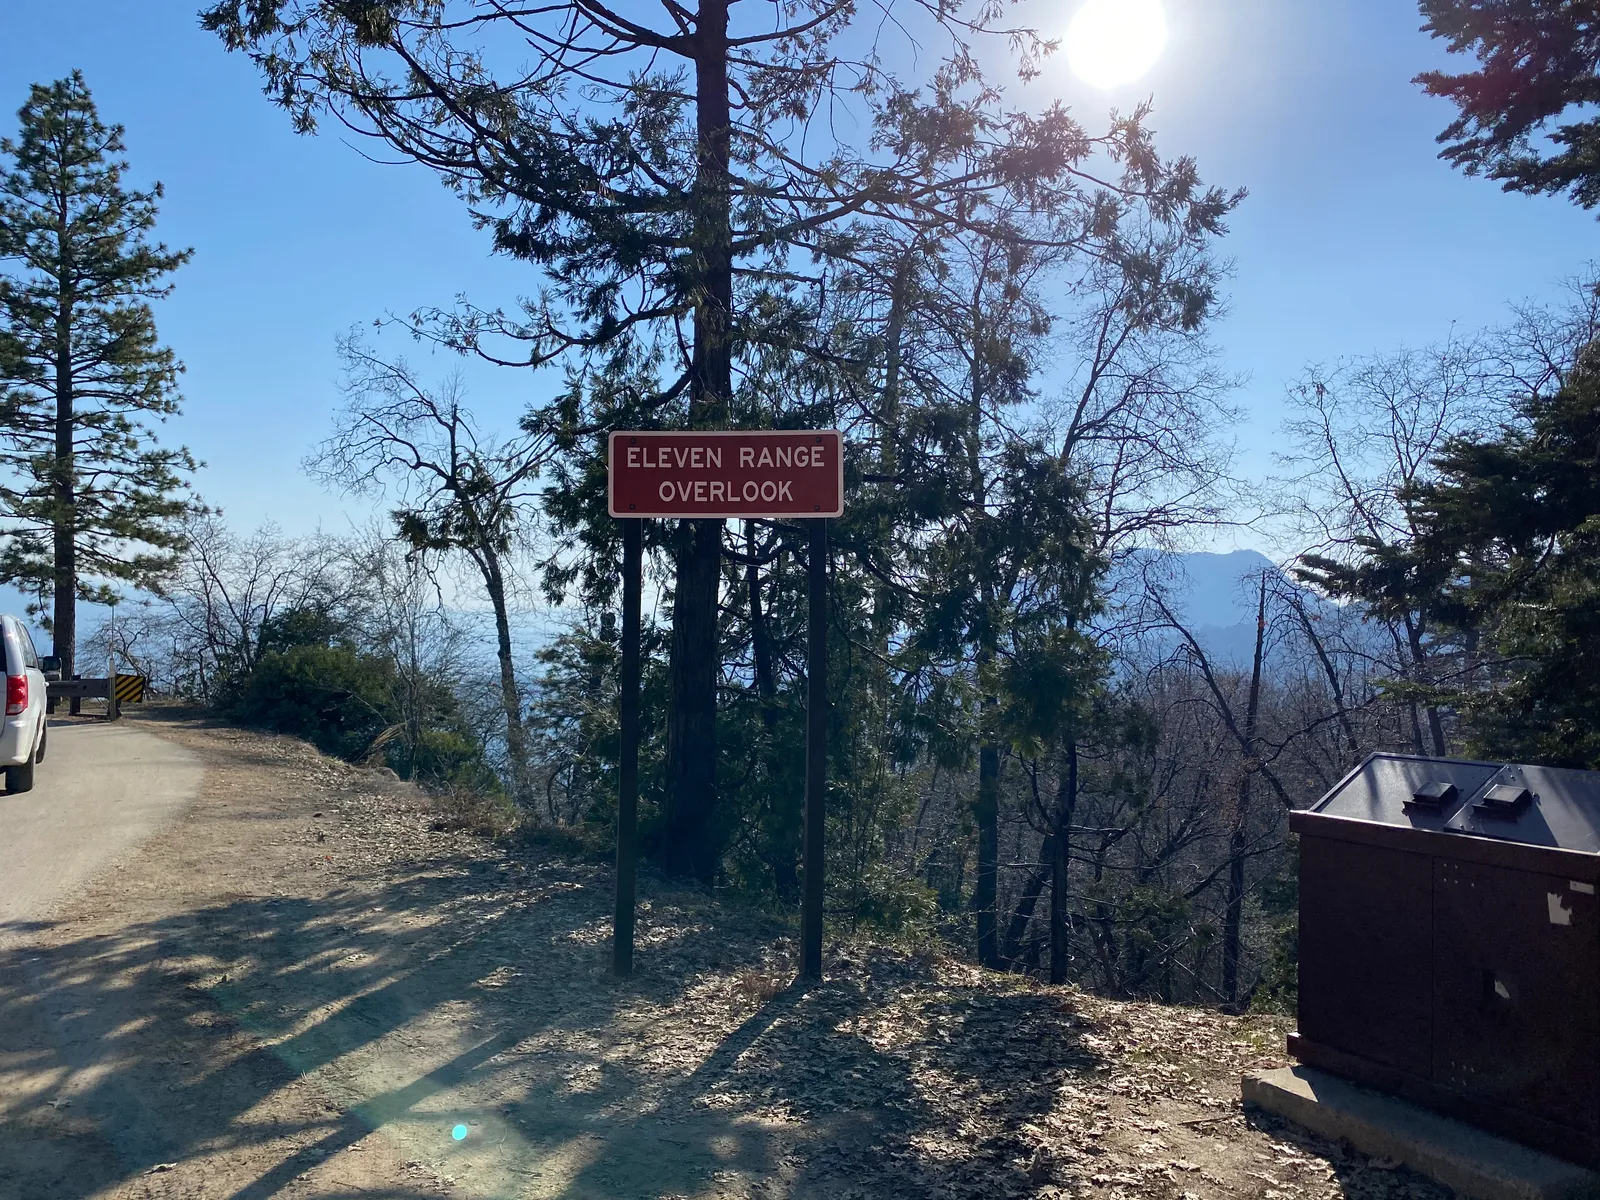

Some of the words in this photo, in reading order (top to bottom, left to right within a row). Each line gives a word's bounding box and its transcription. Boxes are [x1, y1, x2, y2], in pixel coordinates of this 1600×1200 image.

[627, 447, 722, 468] ELEVEN
[739, 446, 825, 468] RANGE
[658, 480, 794, 502] OVERLOOK
